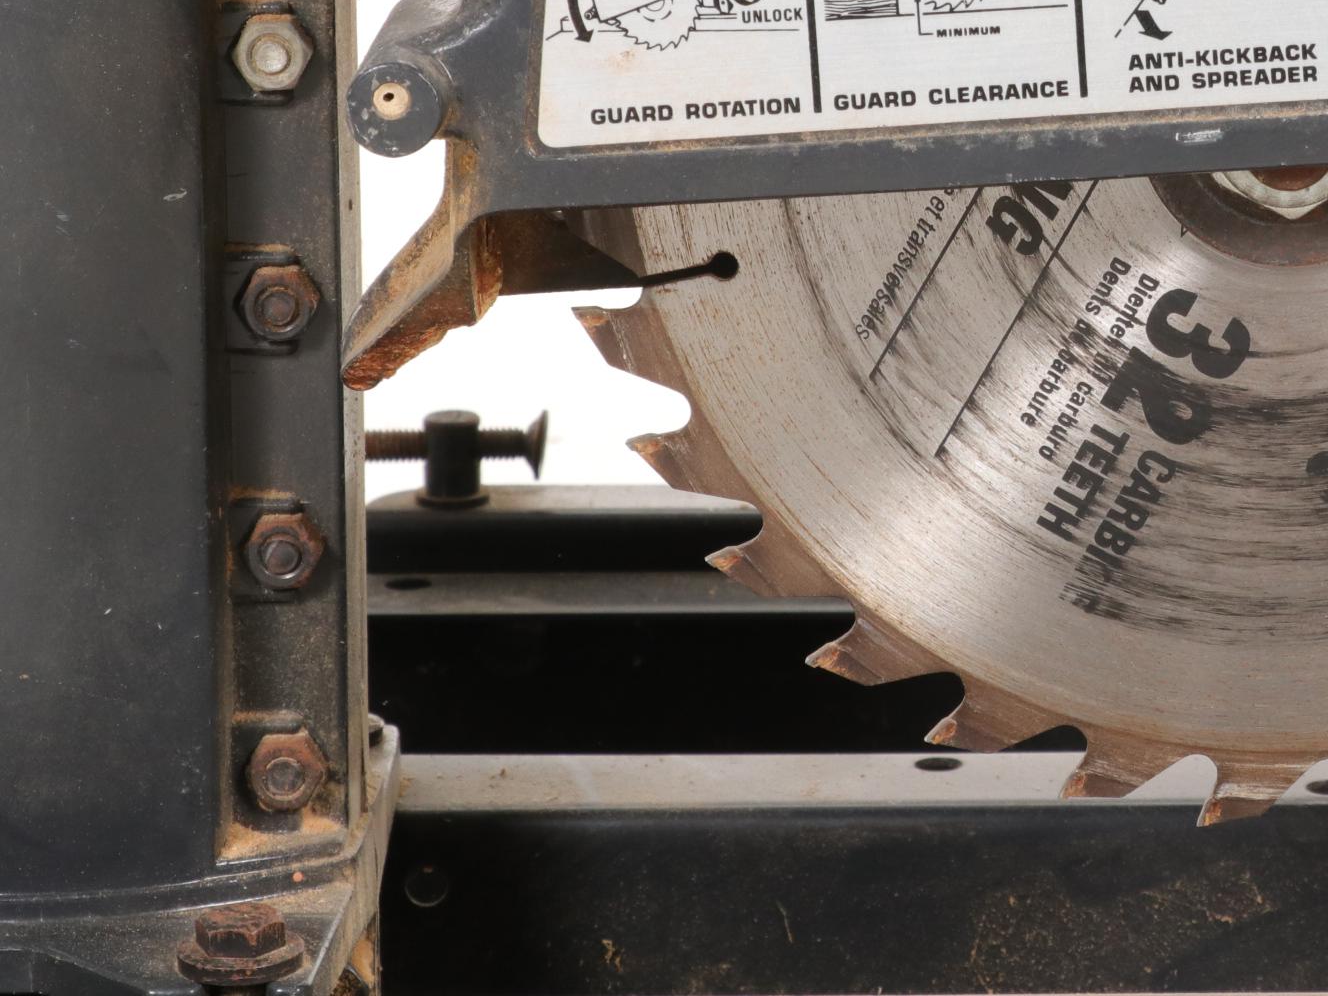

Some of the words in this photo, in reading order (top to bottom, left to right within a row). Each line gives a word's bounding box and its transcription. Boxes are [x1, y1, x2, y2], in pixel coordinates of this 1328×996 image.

[741, 7, 803, 24] UNLOCK
[936, 25, 1001, 38] MINIMUM
[1128, 44, 1318, 70] ANTI-KICKBACK
[1128, 73, 1180, 93] AND
[1191, 66, 1318, 89] SPREADER
[833, 90, 917, 111] GUARD
[928, 80, 1070, 105] CLEARANCE
[590, 104, 674, 125] GUARD
[685, 97, 801, 120] ROTATION
[1083, 256, 1131, 316] Dents
[1100, 287, 1250, 445] 32
[1036, 380, 1093, 461] carburo
[1035, 423, 1130, 542] TEETH
